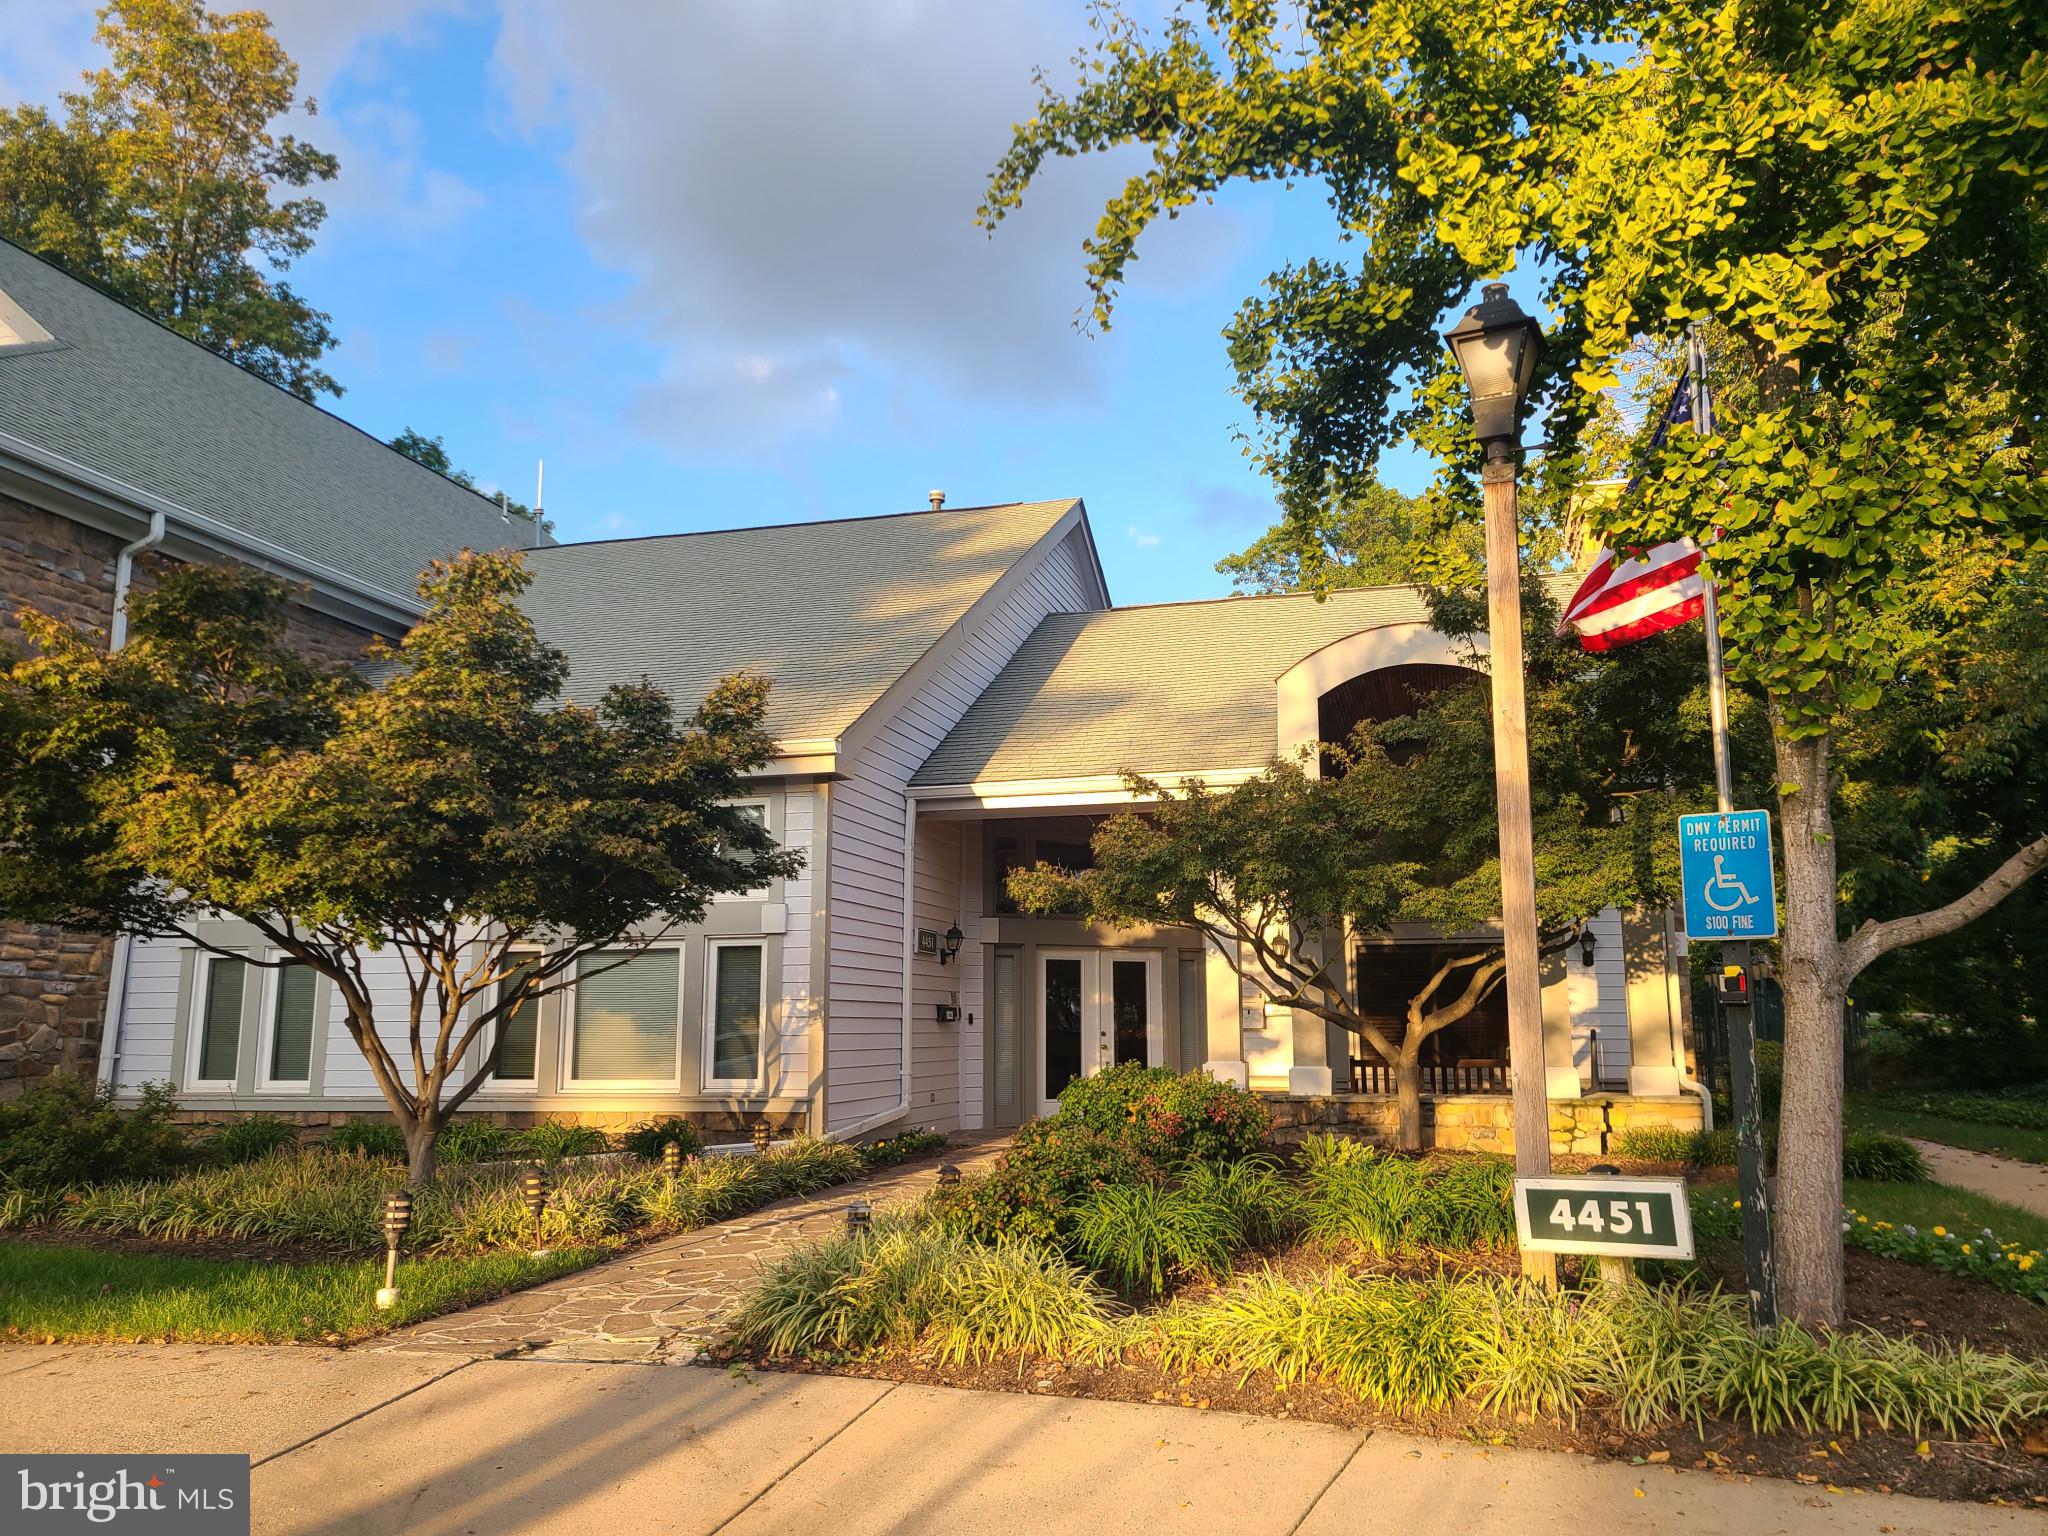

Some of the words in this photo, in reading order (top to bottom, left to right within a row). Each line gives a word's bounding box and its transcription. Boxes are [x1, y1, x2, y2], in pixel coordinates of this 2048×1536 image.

[1686, 821, 1711, 836] DMV
[1717, 817, 1761, 834] PERMIT
[1694, 835, 1756, 852] REQUIRED
[1732, 914, 1754, 929] FINE
[1549, 1198, 1653, 1235] 4451
